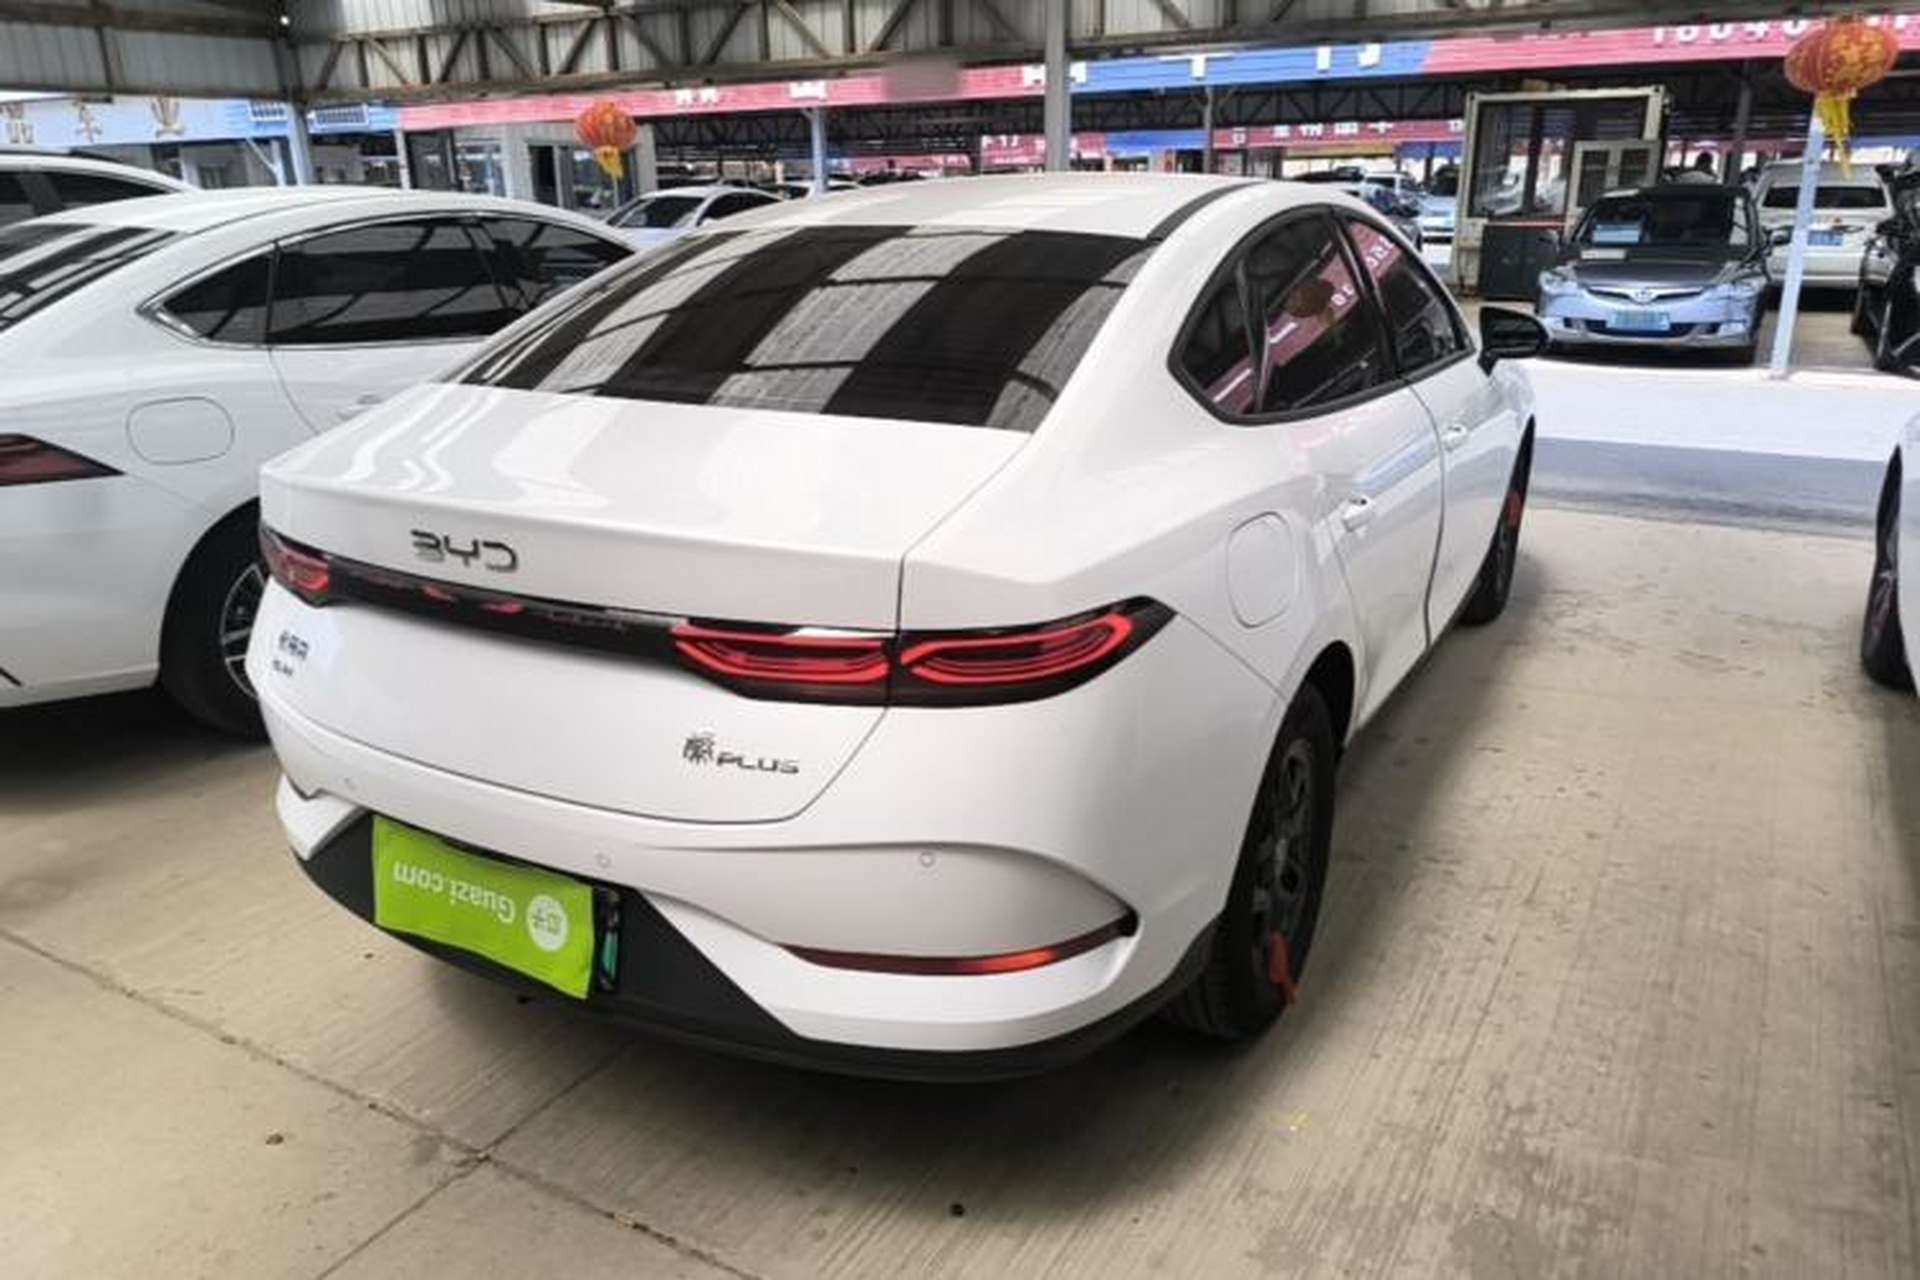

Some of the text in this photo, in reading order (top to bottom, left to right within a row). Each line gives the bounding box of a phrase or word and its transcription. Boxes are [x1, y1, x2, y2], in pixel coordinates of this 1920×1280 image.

[410, 529, 518, 573] BYD
[716, 751, 799, 774] PLUS
[393, 861, 516, 924] Guazi.com
